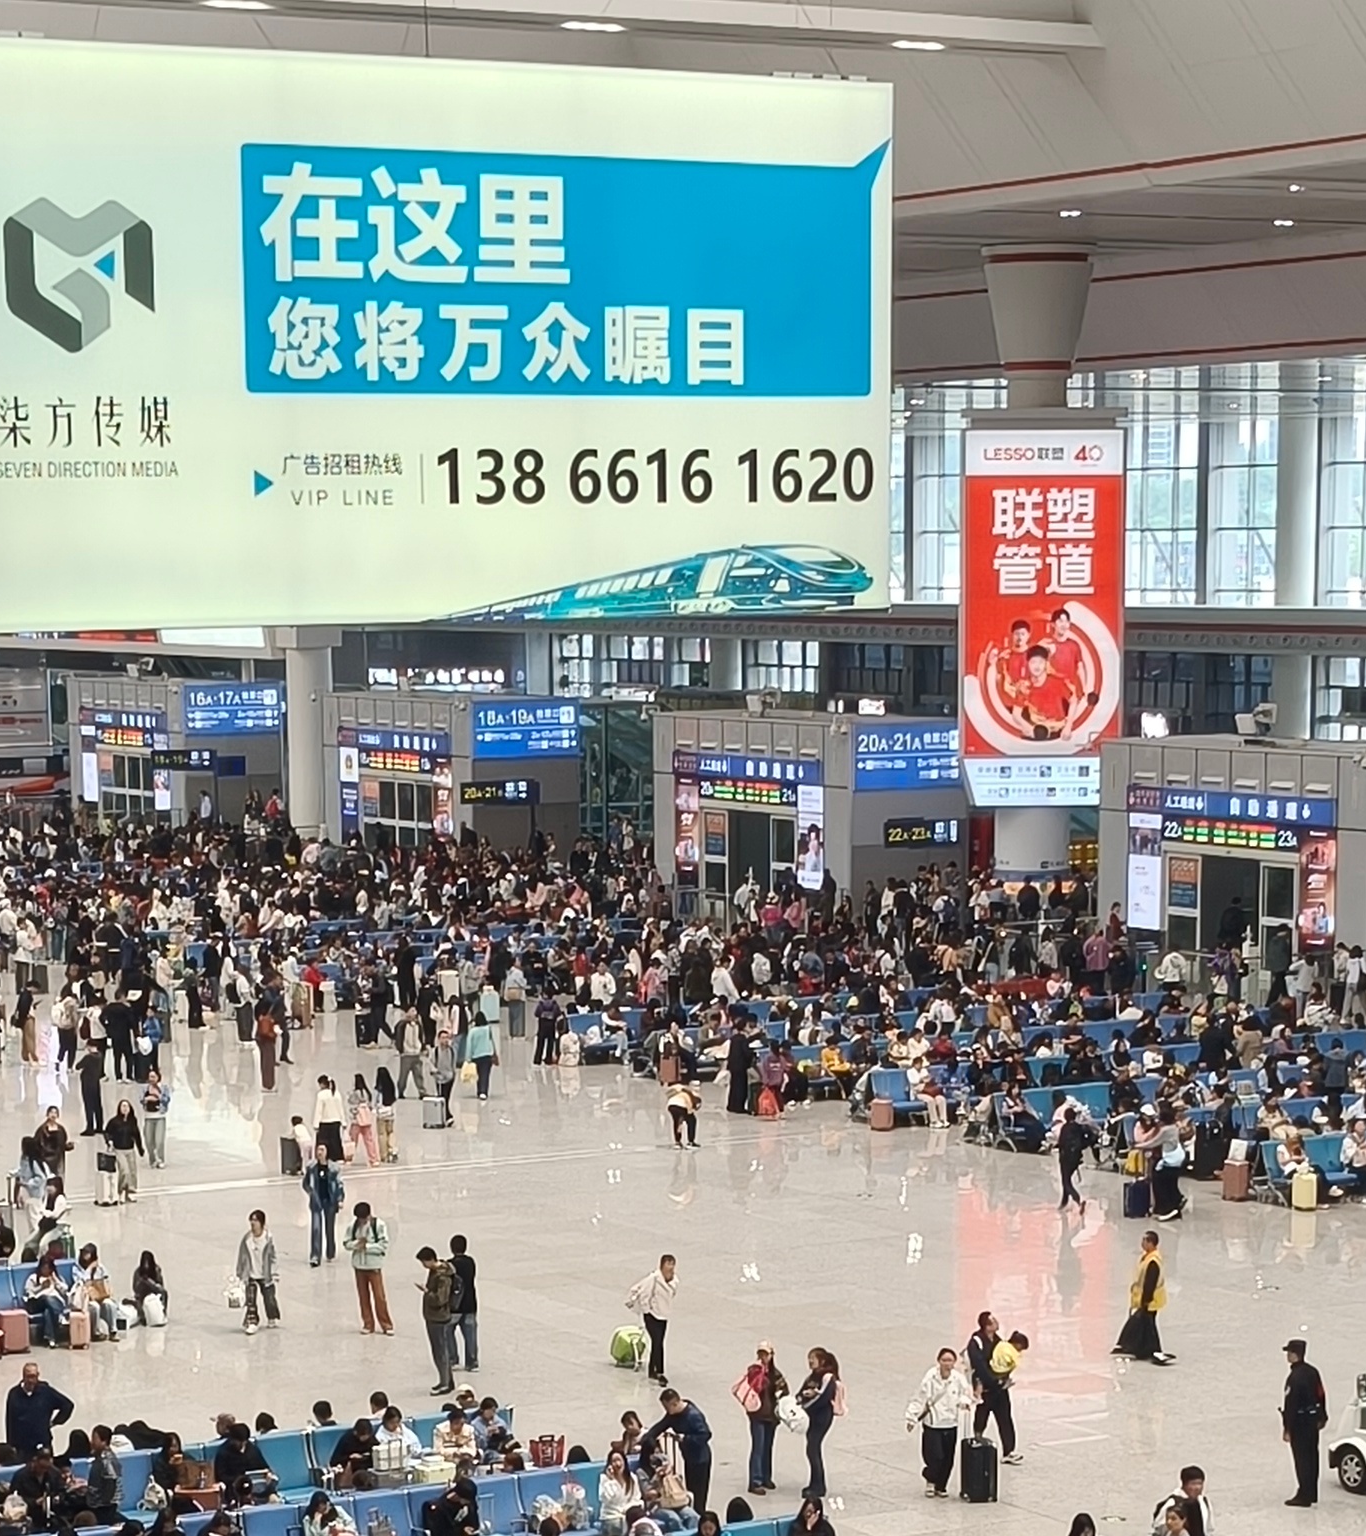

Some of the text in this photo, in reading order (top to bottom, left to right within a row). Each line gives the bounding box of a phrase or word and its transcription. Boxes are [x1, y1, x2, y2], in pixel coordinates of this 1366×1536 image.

[260, 161, 572, 287] 在这里
[266, 296, 747, 388] 您将万众瞩目
[47, 461, 127, 478] DIRECTION
[131, 461, 180, 478] MEDIA
[281, 453, 404, 476] 广告招租热线
[983, 447, 1035, 461] LESSO
[436, 446, 875, 506] 138 6616 1620
[290, 488, 395, 506] VIP LINE
[991, 487, 1096, 539] 联塑
[992, 543, 1095, 595] 管道
[857, 732, 922, 752] 20A·21A
